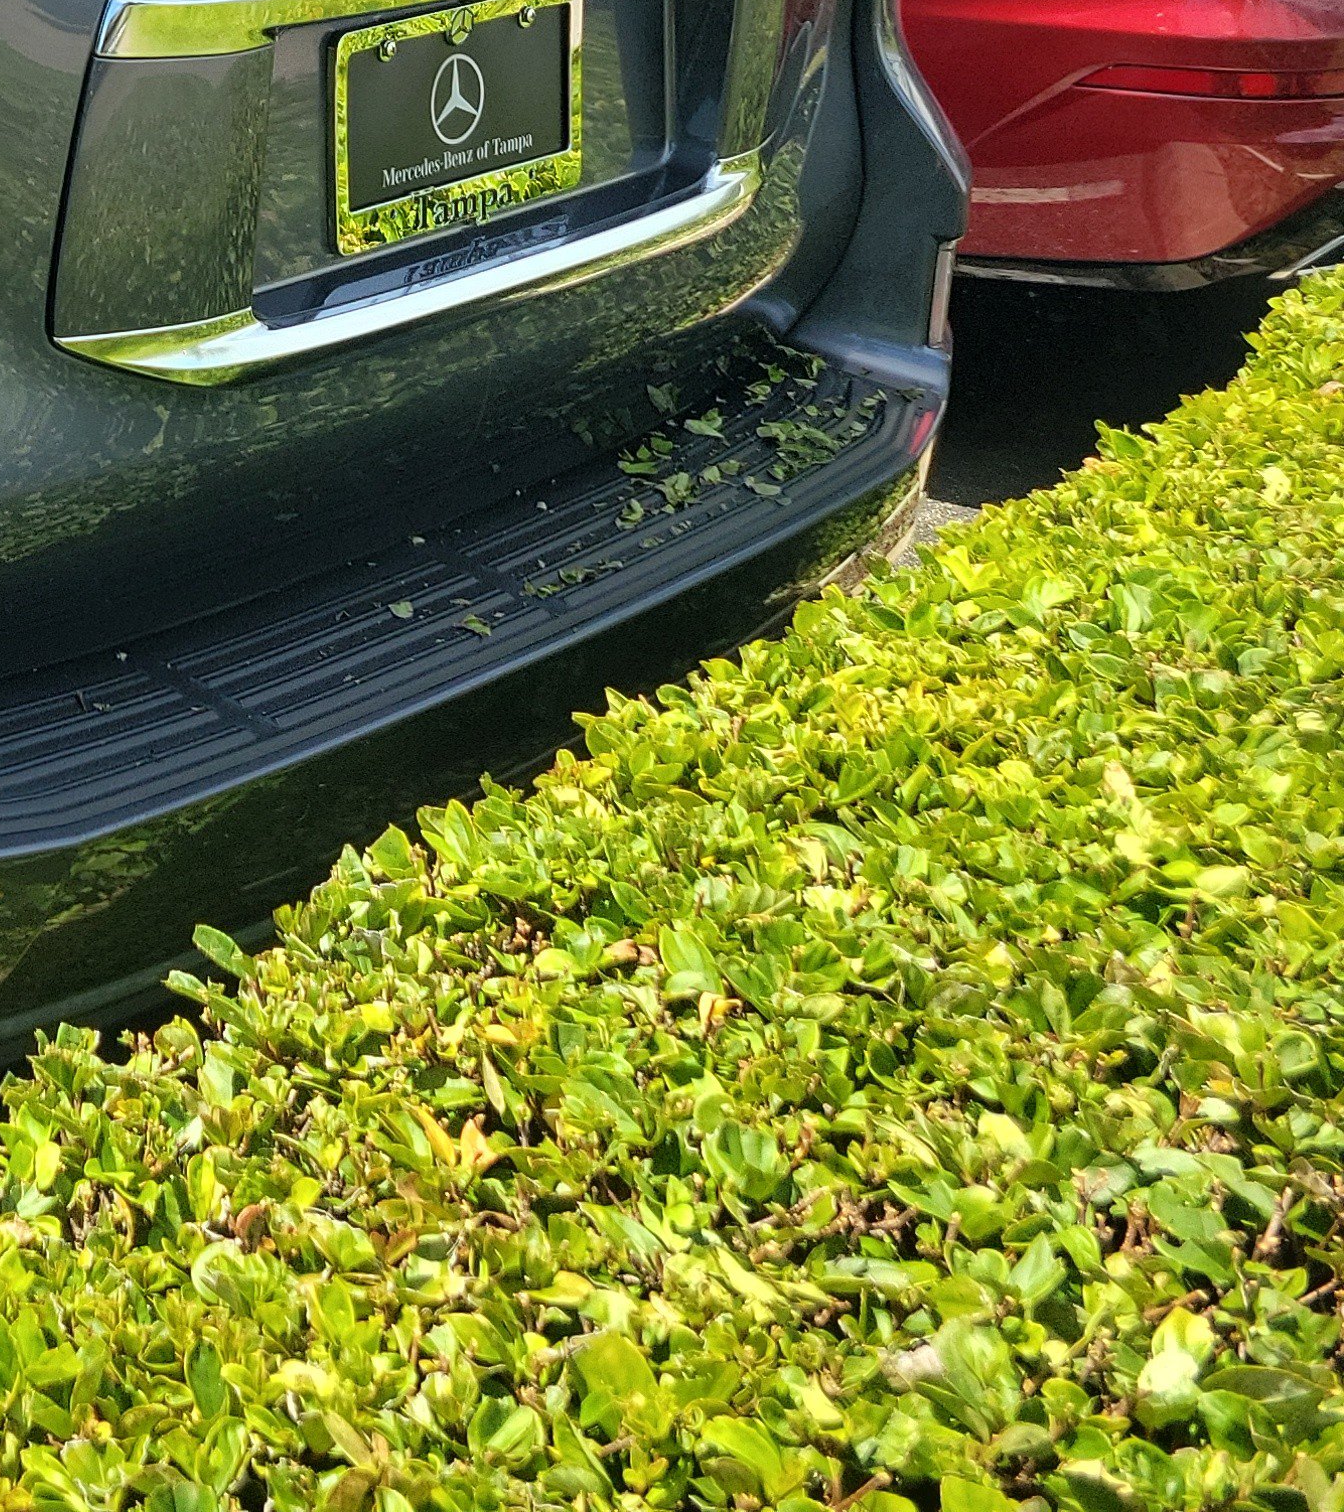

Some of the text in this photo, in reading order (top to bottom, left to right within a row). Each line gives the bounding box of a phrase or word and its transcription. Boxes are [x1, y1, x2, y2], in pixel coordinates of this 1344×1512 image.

[382, 132, 533, 188] Mercedes-Benz of Tampa
[411, 182, 514, 231] Tampa
